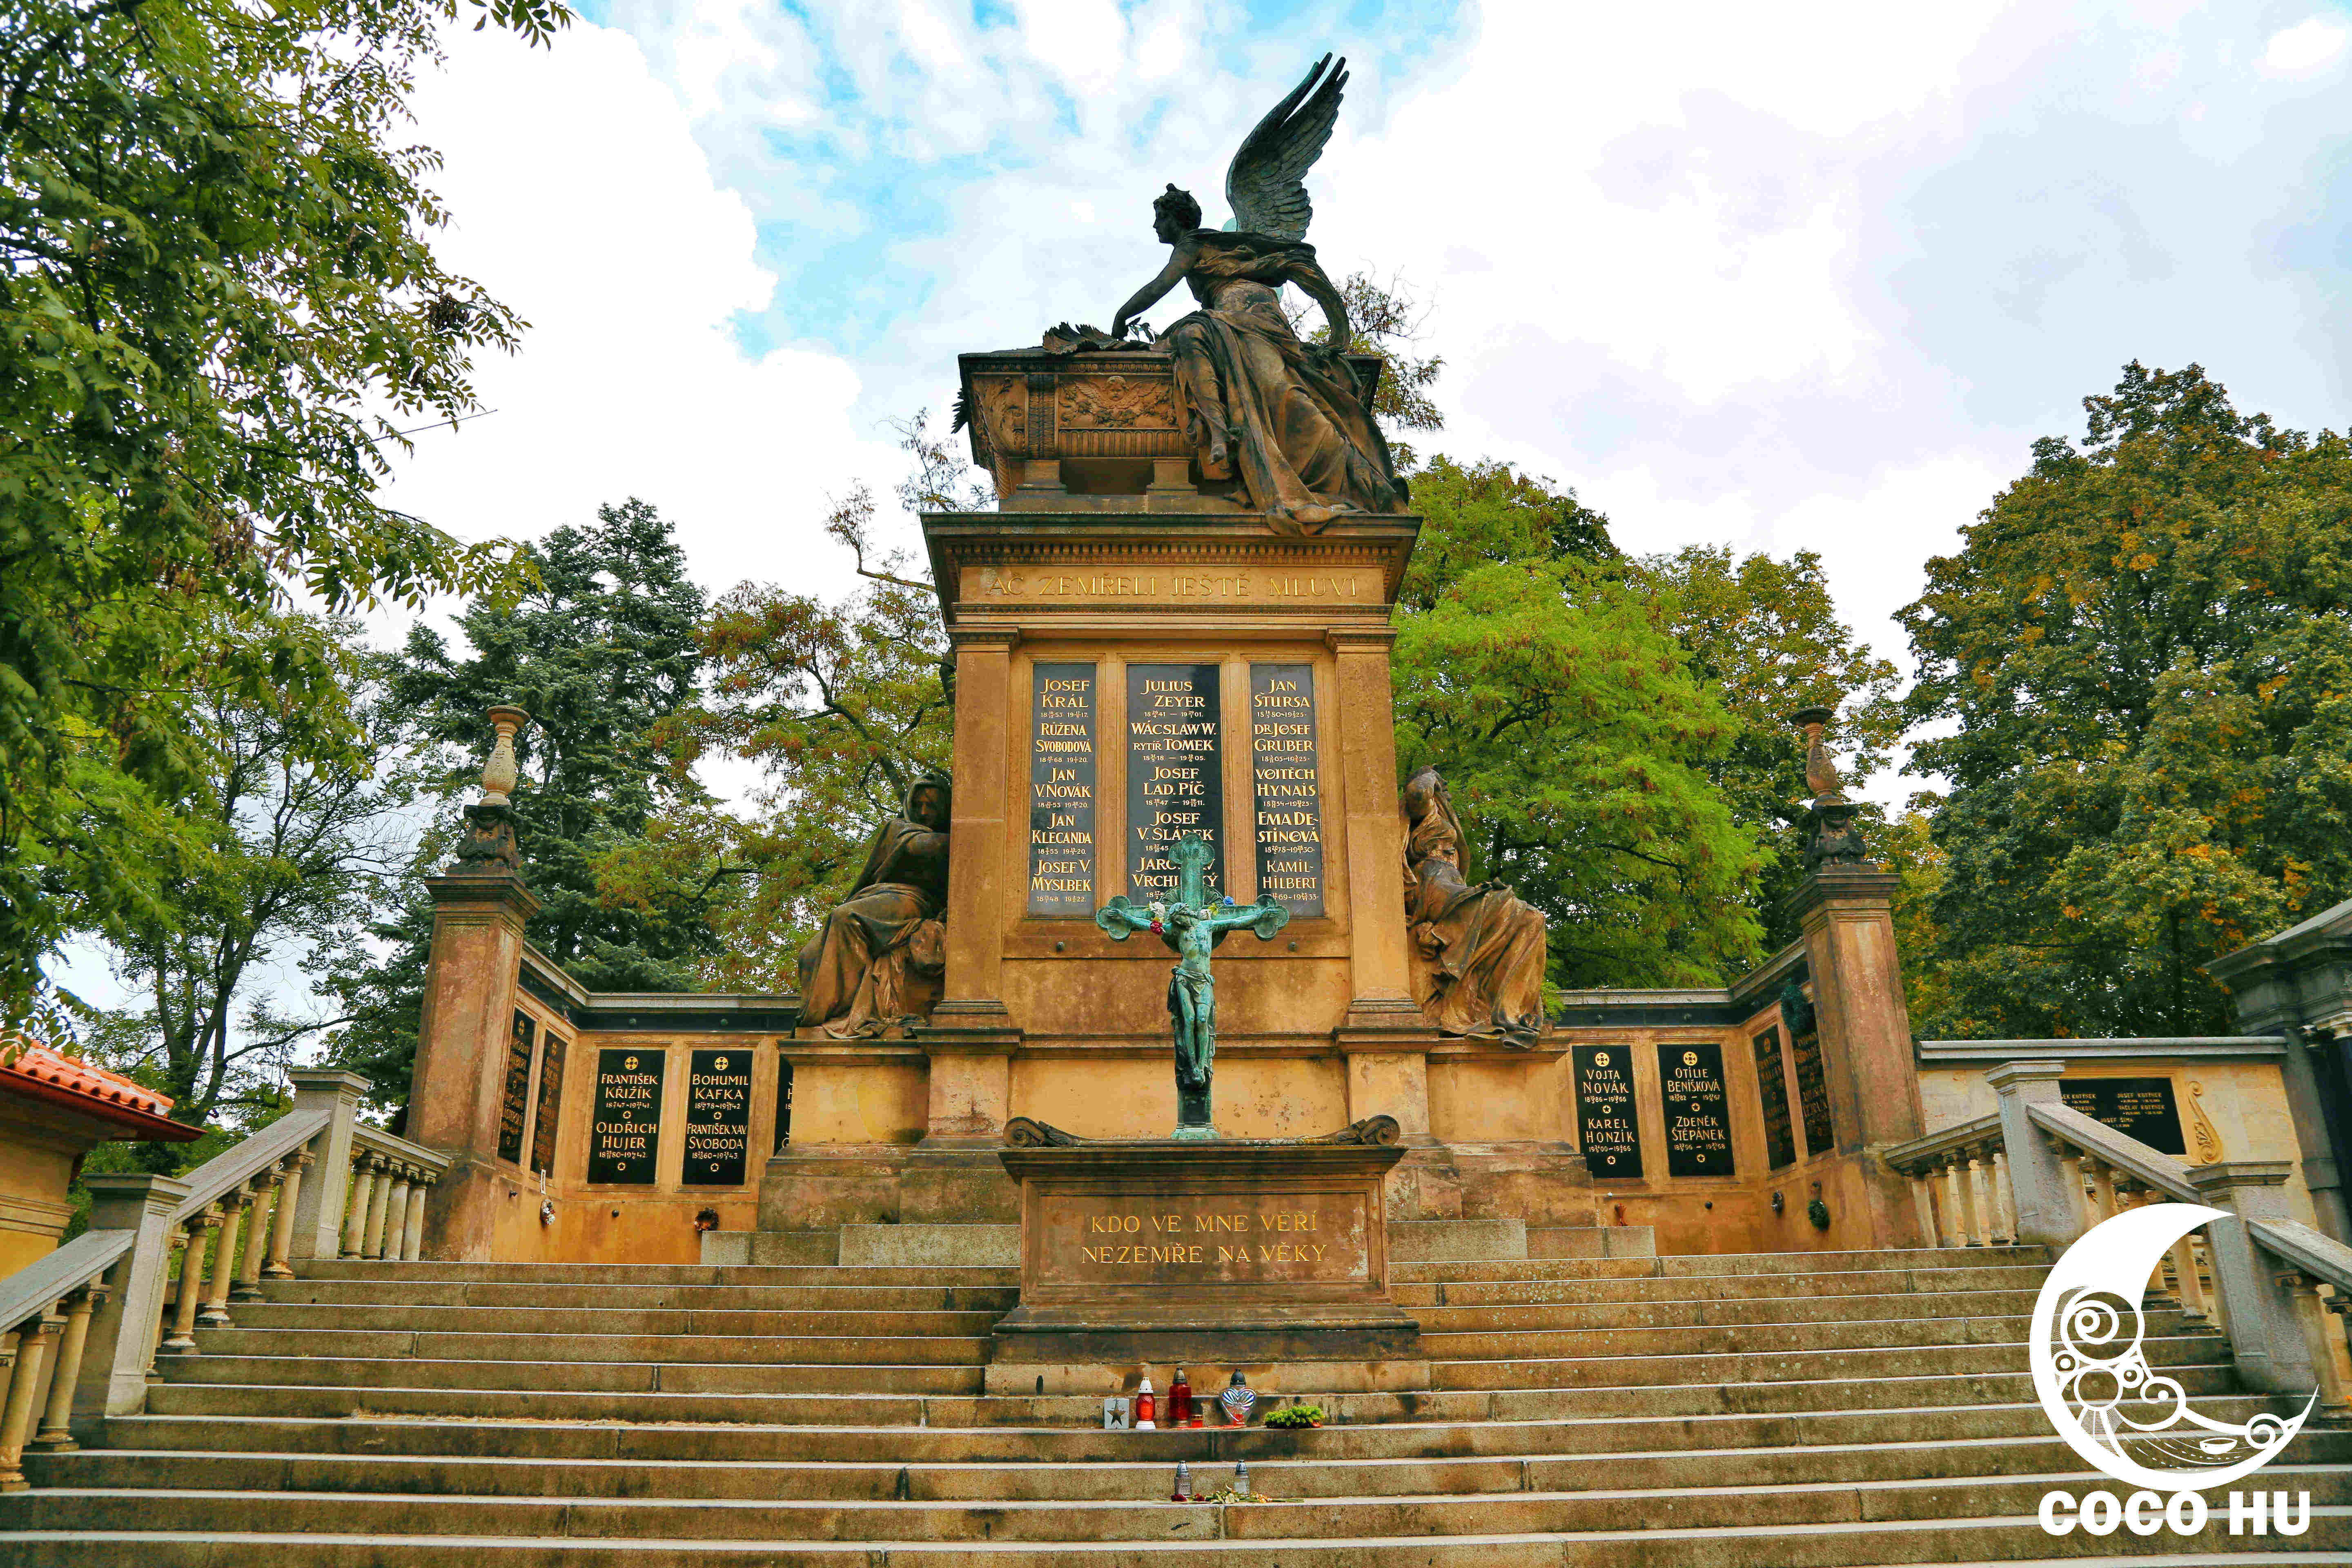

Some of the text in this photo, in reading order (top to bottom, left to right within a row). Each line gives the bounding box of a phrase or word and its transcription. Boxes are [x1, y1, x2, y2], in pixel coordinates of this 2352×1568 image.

[985, 573, 1358, 597] AČ ZEMŘELI JEŠTĚ MLUVÍ
[1040, 679, 1090, 694] JOSEF
[1140, 679, 1193, 695] JULIUS
[1268, 679, 1297, 694] JAN
[1042, 694, 1089, 708] KRÁL
[1154, 695, 1205, 707] ZEYER
[1254, 693, 1310, 708] ŠTURSA
[1131, 720, 1217, 735] WÁCSLAW W.
[1272, 722, 1310, 737] JOSEF
[1036, 739, 1091, 752] SVOBODOVÁ
[1134, 738, 1214, 751] RYTÍŘ TOMEK
[1254, 738, 1316, 752] GRUBER
[1048, 768, 1075, 783] JAN
[1149, 766, 1199, 781] JOSEF
[1143, 781, 1205, 795] LAD. PÍČ
[1047, 813, 1075, 829] JAN
[1150, 811, 1200, 826] JOSEF
[1258, 811, 1292, 825] EMA
[1032, 830, 1092, 844] KLECANDA
[1137, 827, 1149, 840] V.
[1034, 859, 1091, 876] JOSEF V.
[1031, 877, 1091, 891] MYSLBEK
[1263, 875, 1316, 889] HILBERT
[601, 1073, 660, 1085] FRANTIŠEK
[693, 1074, 748, 1085] BOHUMIL
[1586, 1069, 1620, 1080] VOJTA
[606, 1086, 652, 1098] KŘIŽÍK
[695, 1087, 744, 1099] KAFKA
[1583, 1080, 1629, 1094] NOVÁK
[597, 1121, 657, 1134] OLDŘICH
[687, 1123, 730, 1134] FRANTIŠEK
[1588, 1118, 1628, 1129] KAREL
[1676, 1116, 1718, 1127] ZDENĚK
[1586, 1129, 1635, 1143] HONZÍK
[1672, 1127, 1725, 1140] ŠTĚPÁNEK
[603, 1136, 646, 1150] HUJER
[689, 1136, 744, 1149] SVOBODA
[1091, 1210, 1317, 1232] KDO VE MNE VĚŘÍ
[1082, 1241, 1327, 1263] NEZEMŘE NA VĚKY
